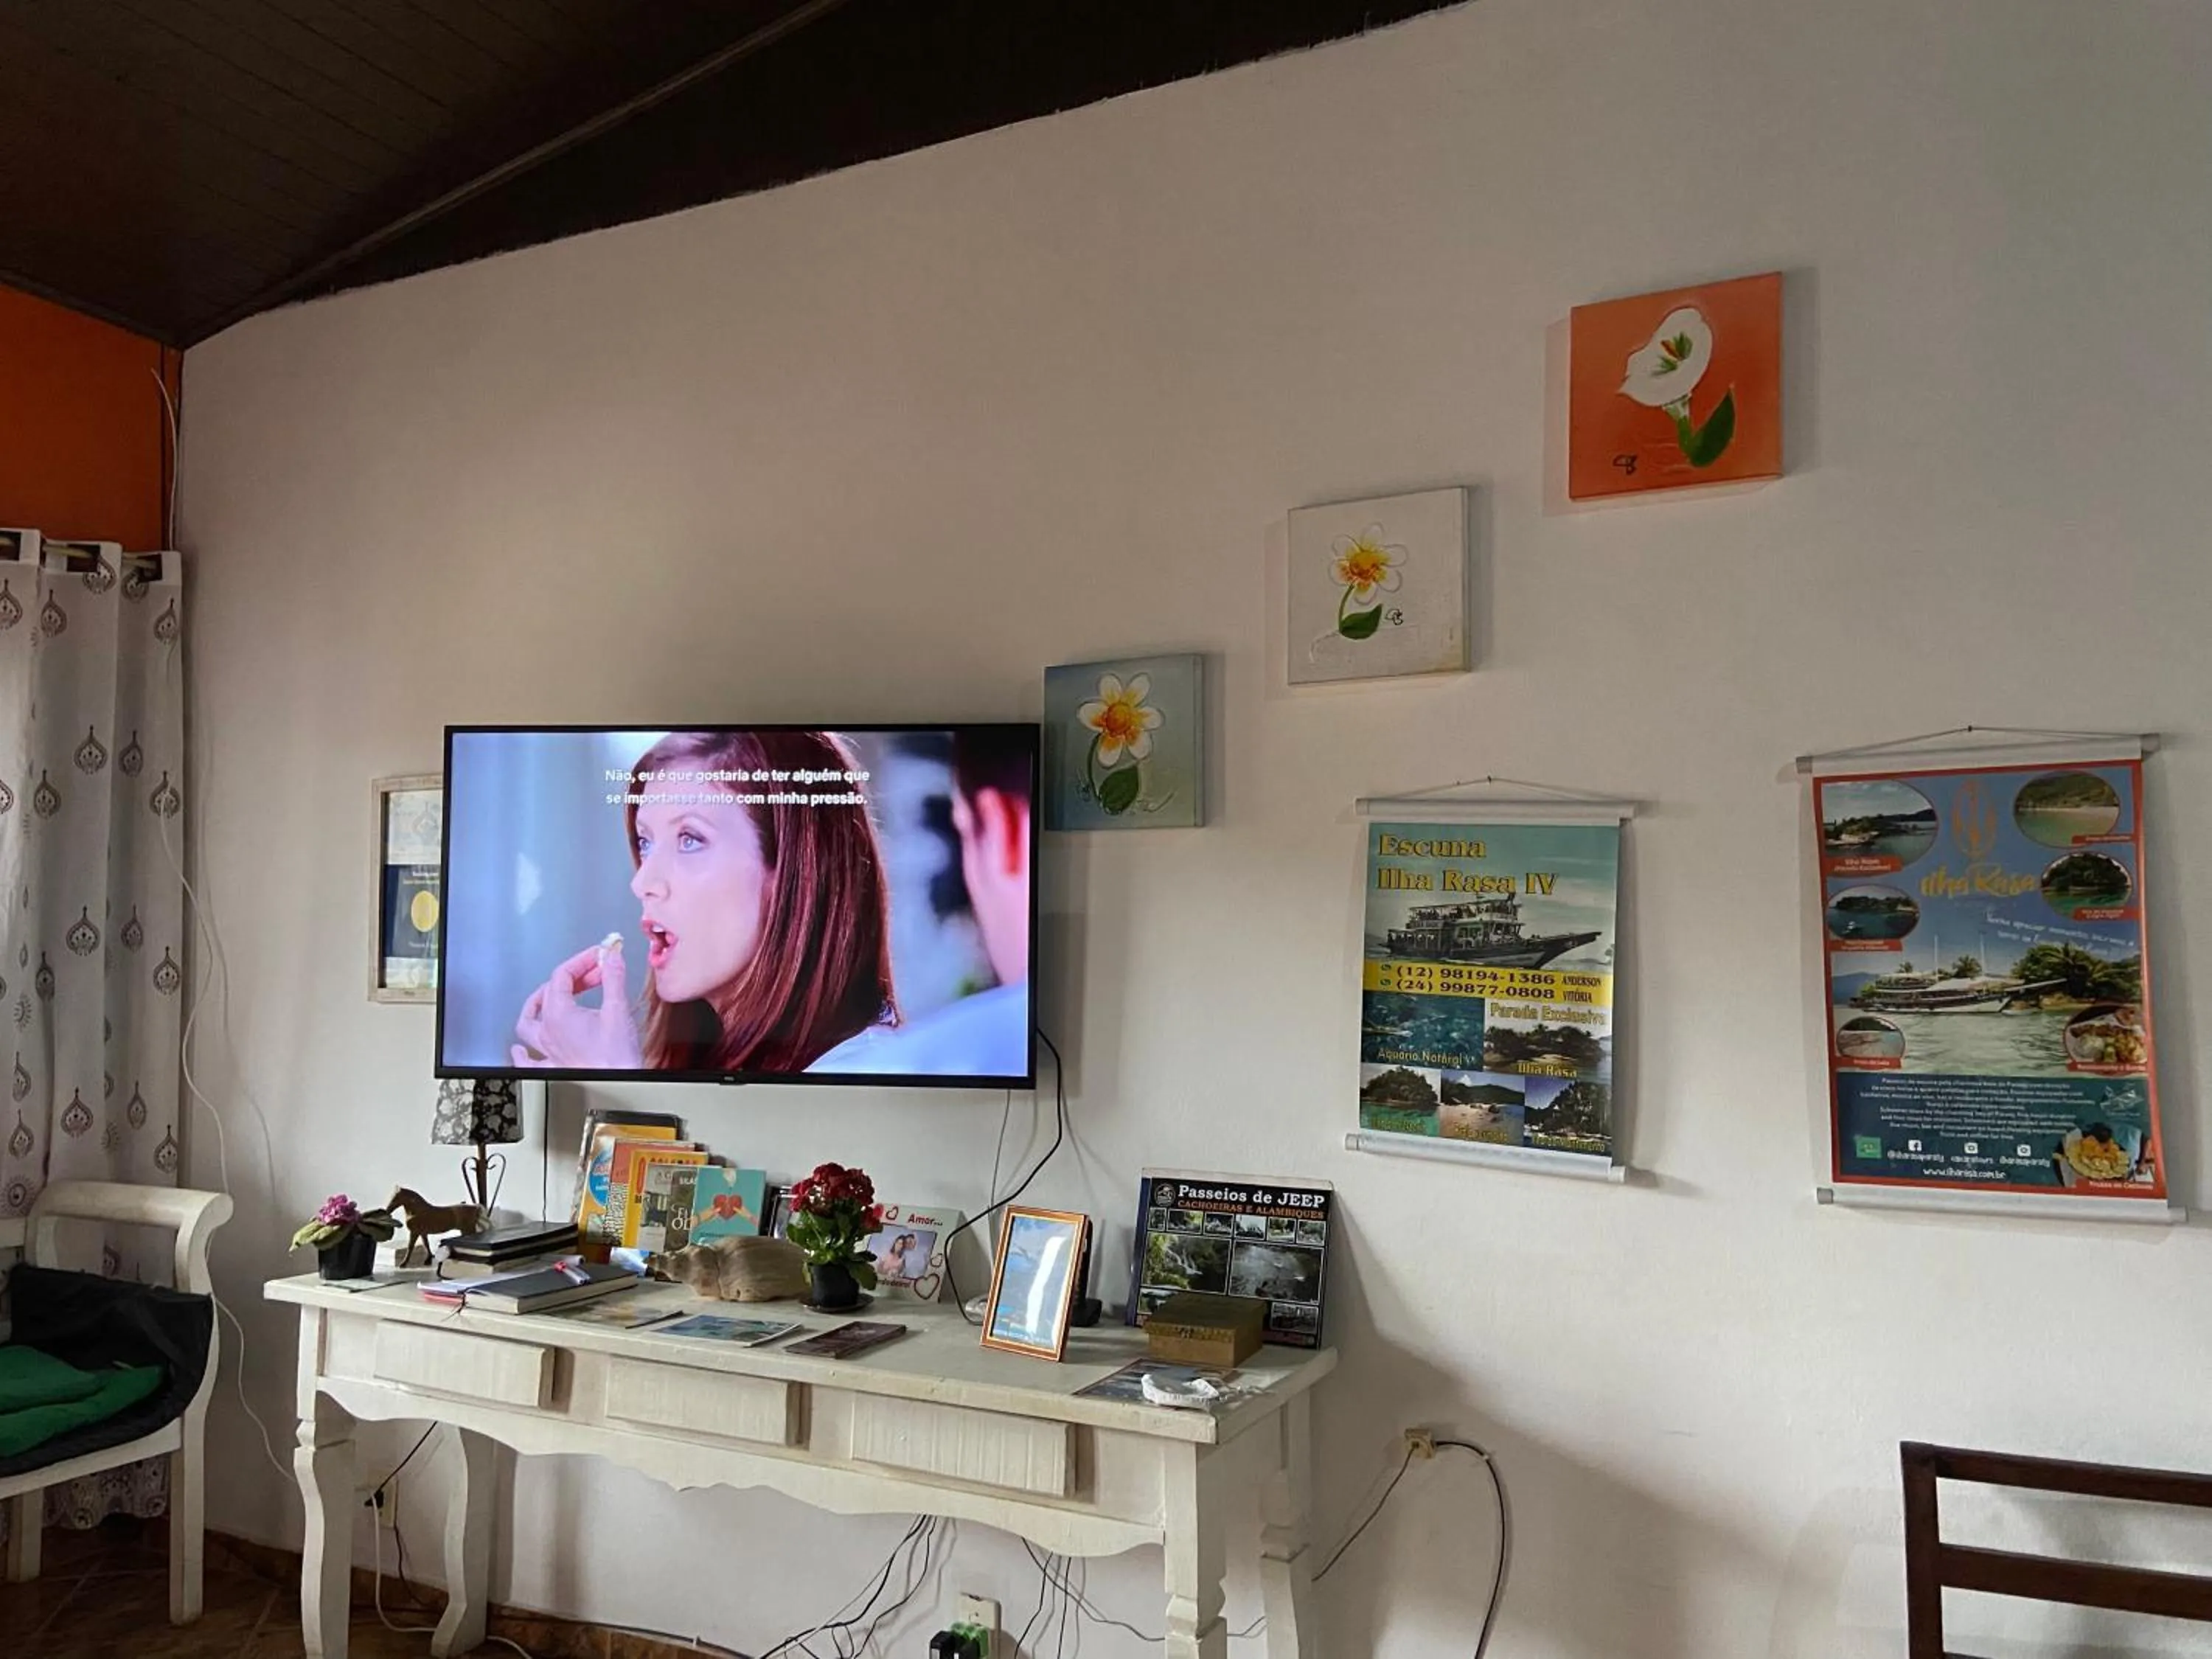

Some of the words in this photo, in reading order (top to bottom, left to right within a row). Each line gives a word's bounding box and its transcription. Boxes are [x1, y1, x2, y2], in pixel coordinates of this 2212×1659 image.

[605, 768, 636, 782] Não,
[638, 771, 655, 782] eu
[658, 769, 666, 782] é
[668, 771, 692, 785] que
[697, 769, 749, 785] gostaria
[751, 769, 769, 782] de
[772, 770, 791, 782] ter
[793, 768, 841, 785] alguém
[844, 771, 870, 785] que
[605, 793, 622, 804] se
[737, 793, 765, 805] com
[768, 791, 808, 805] minha
[810, 791, 869, 807] pressão.
[1378, 832, 1487, 859] Escuna
[1377, 868, 1433, 891] Ilha
[1441, 869, 1516, 894] Rasa
[1524, 872, 1559, 895] IV
[1397, 965, 1433, 979] (12)
[1440, 967, 1555, 985] 98194-1386
[1396, 978, 1433, 992] (24)
[1439, 981, 1555, 1000] 99877-0808
[1489, 1002, 1539, 1020] Parada
[1178, 1184, 1248, 1203] Passeios
[1253, 1190, 1273, 1204] de
[1277, 1192, 1326, 1208] JEEP
[1177, 1200, 1243, 1214] CACHOEIRAS
